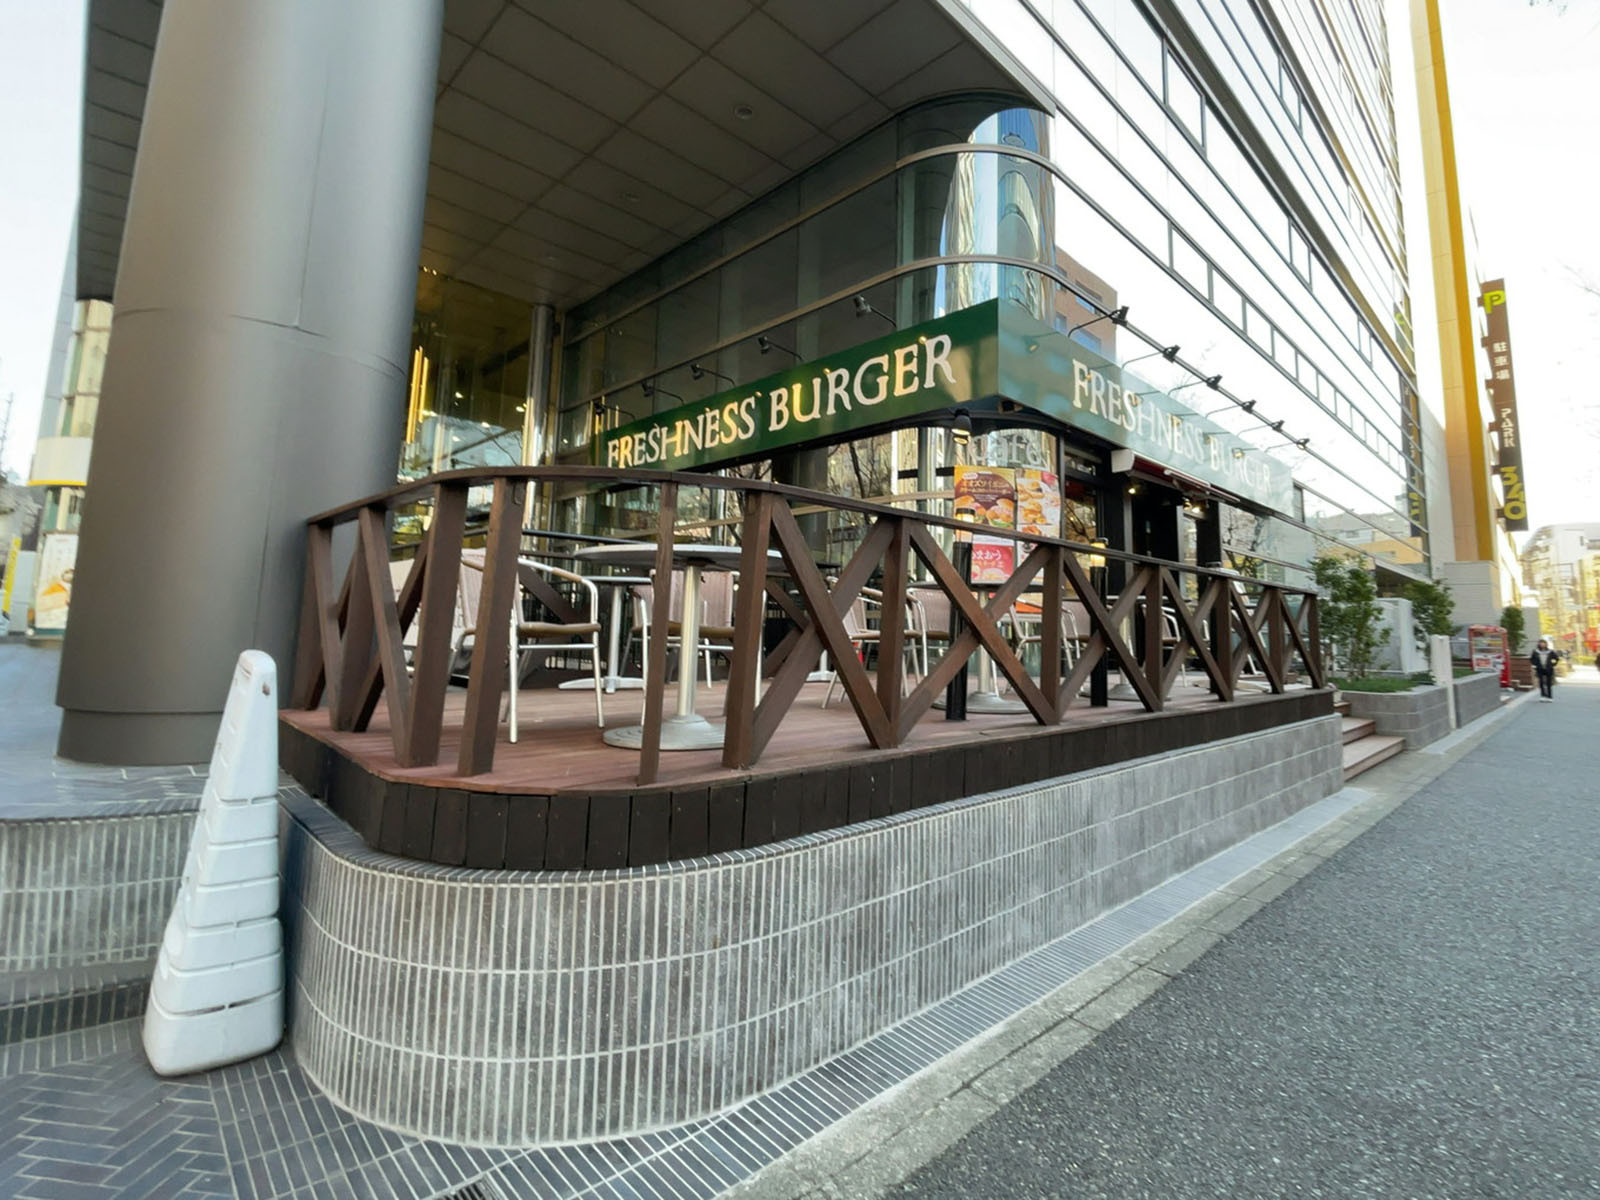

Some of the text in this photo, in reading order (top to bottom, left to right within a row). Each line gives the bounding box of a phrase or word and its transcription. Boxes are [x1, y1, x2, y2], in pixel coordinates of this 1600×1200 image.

[1483, 290, 1506, 314] P
[607, 334, 956, 469] FRESHNESS BURGER
[1072, 359, 1272, 494] FRESHNESS BURGER
[1500, 408, 1516, 448] PARK
[1500, 466, 1527, 521] 340
